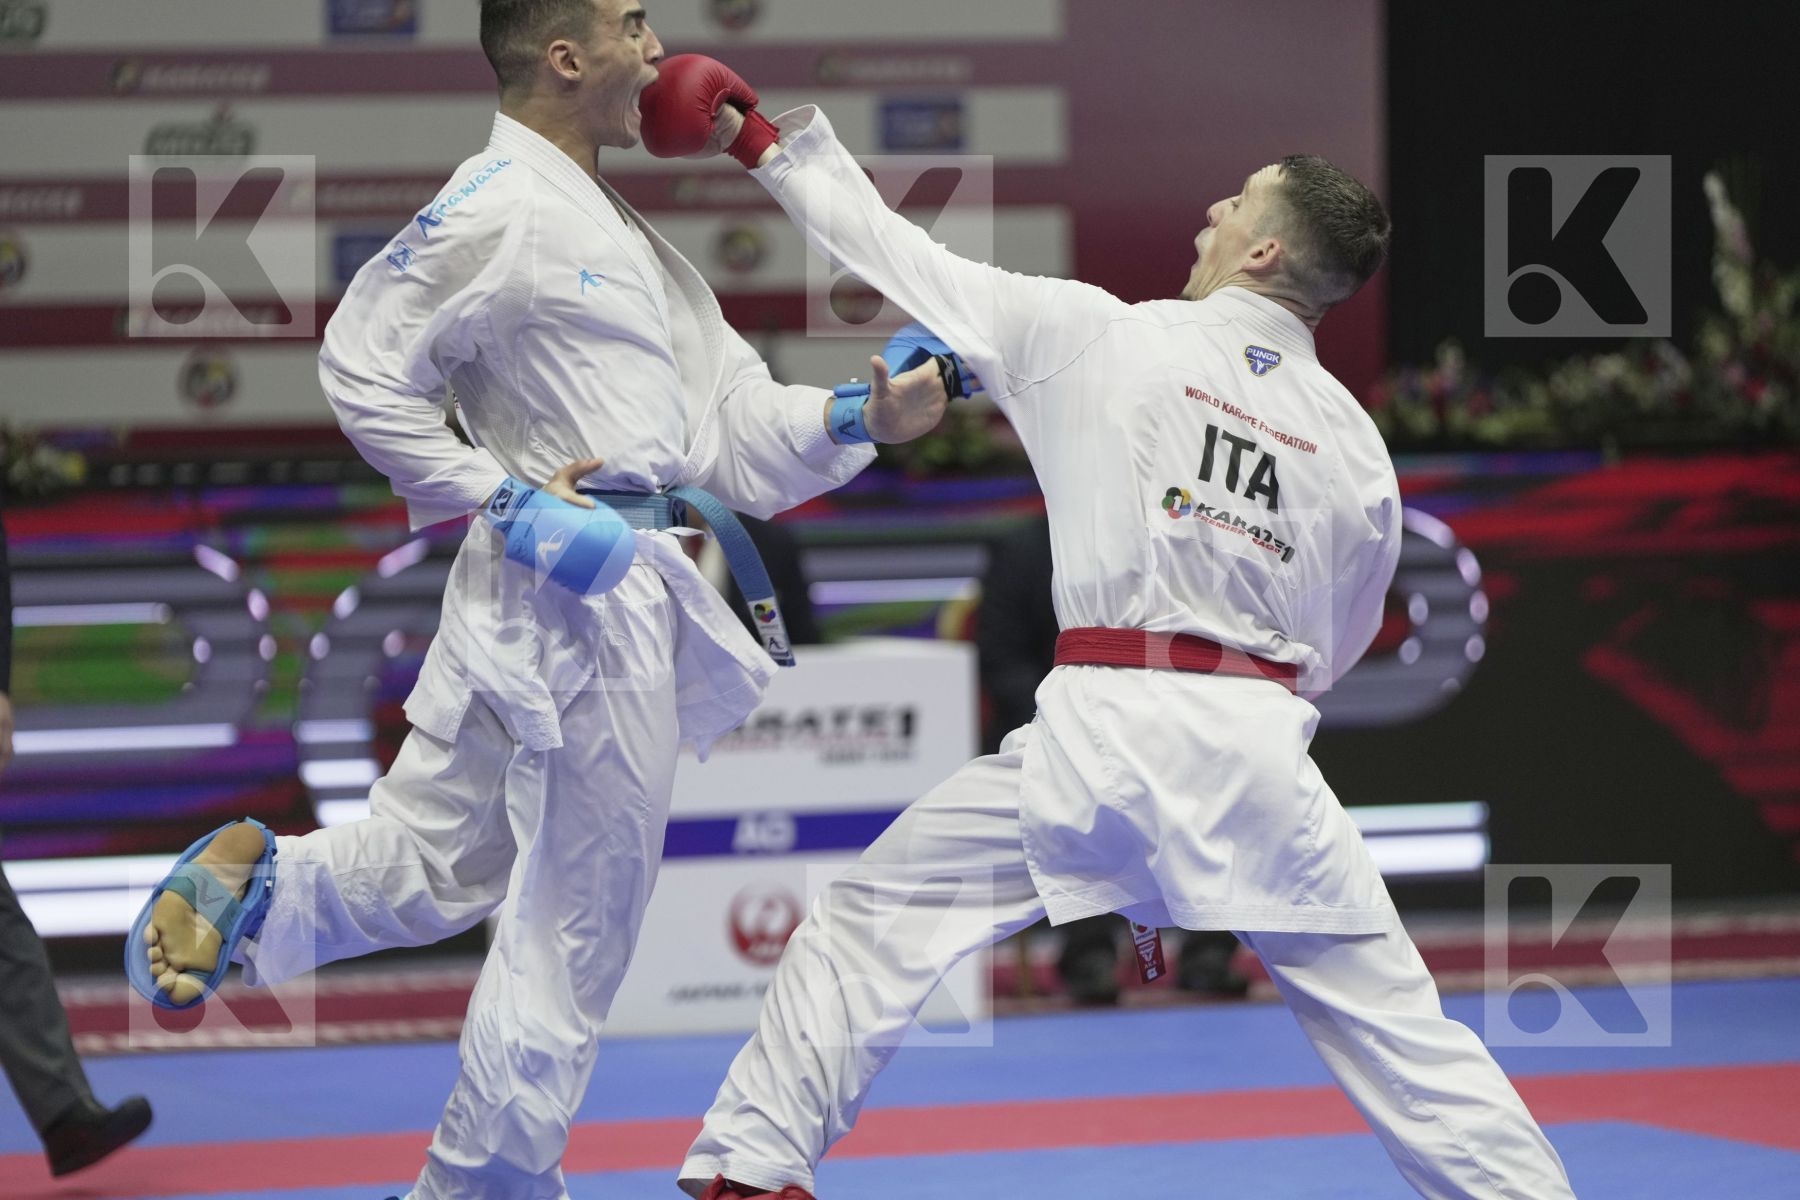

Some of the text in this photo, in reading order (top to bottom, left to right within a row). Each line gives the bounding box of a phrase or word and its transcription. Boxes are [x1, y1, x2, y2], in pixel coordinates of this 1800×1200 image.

[1185, 385, 1318, 455] WORLD KARATE FEDERATION
[1197, 423, 1280, 515] ITA
[1193, 511, 1247, 537] PREMIER
